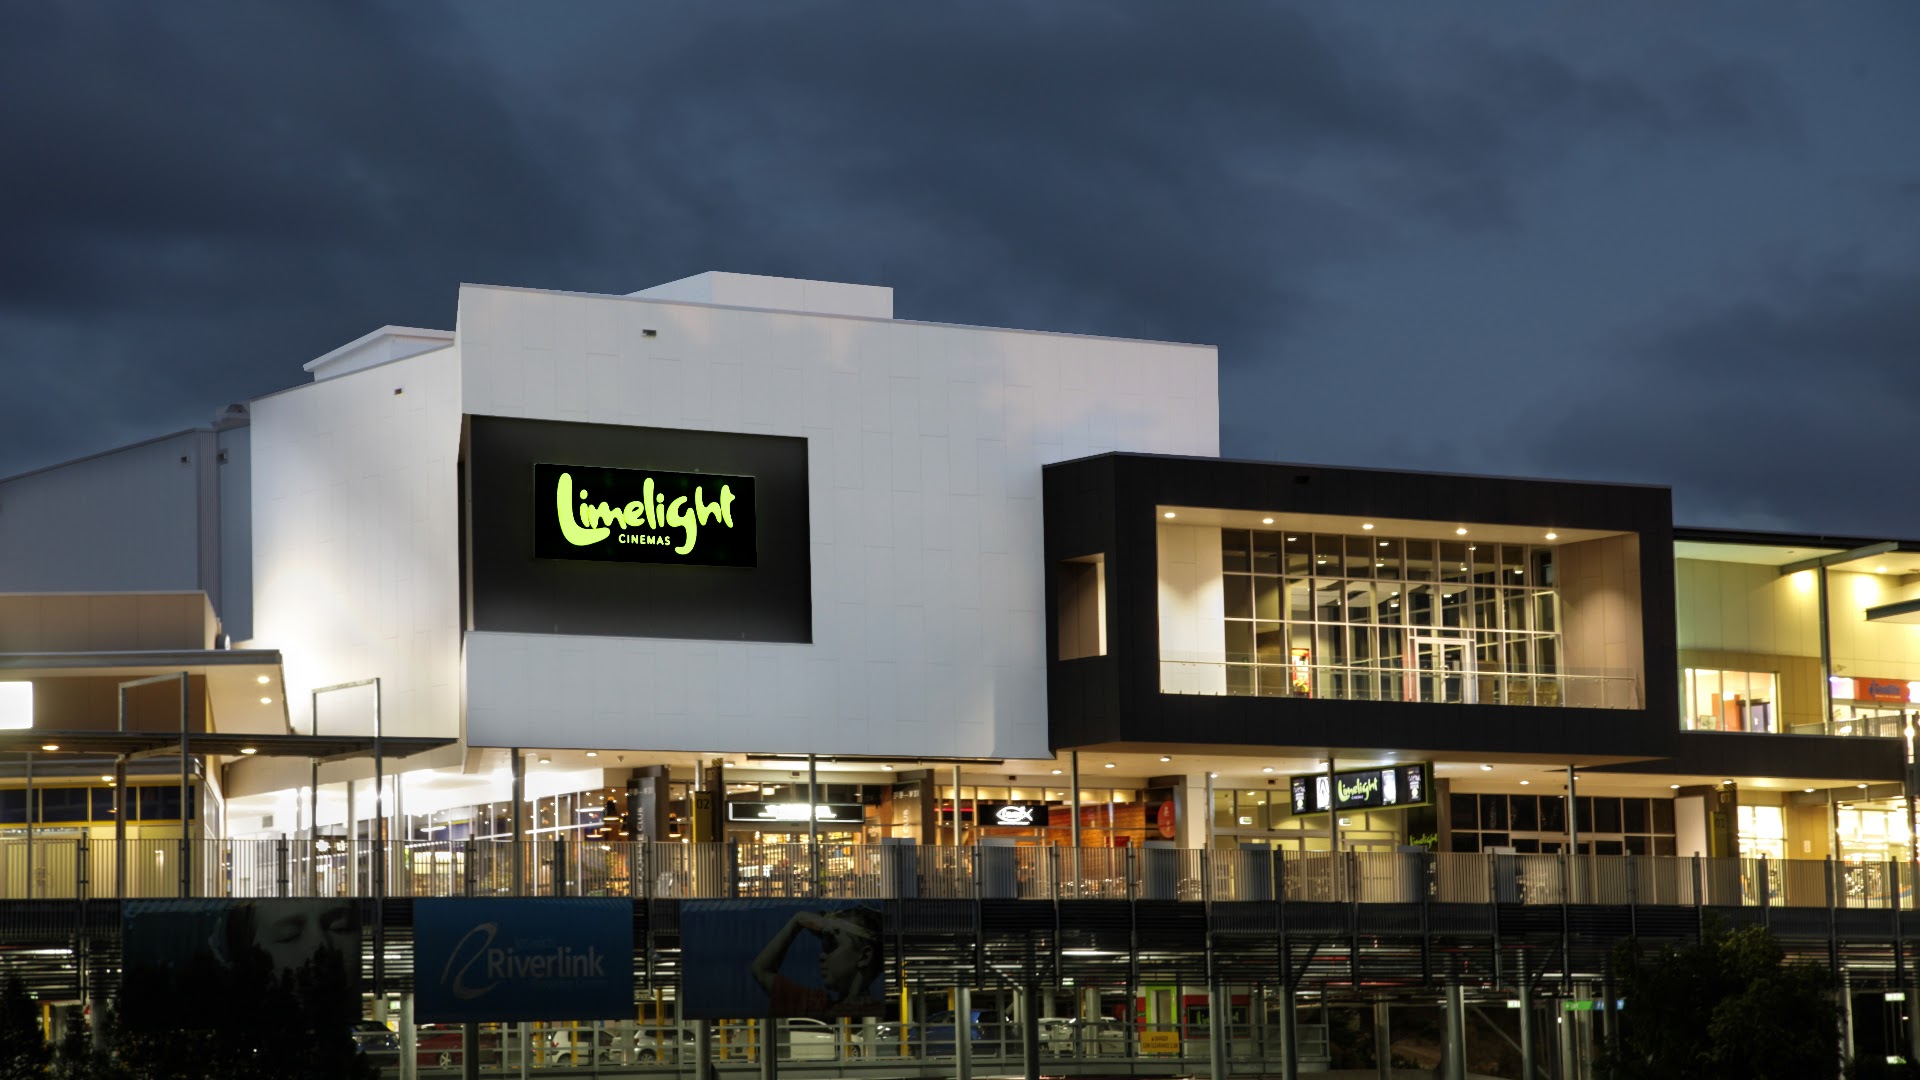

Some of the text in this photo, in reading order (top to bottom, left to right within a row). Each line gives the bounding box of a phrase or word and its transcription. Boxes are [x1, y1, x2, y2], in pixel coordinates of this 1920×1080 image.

[556, 472, 735, 555] Limelight
[618, 533, 671, 546] CINEMAS
[1337, 777, 1378, 802] Limelight
[696, 799, 710, 810] 02
[487, 945, 606, 978] Riverlink
